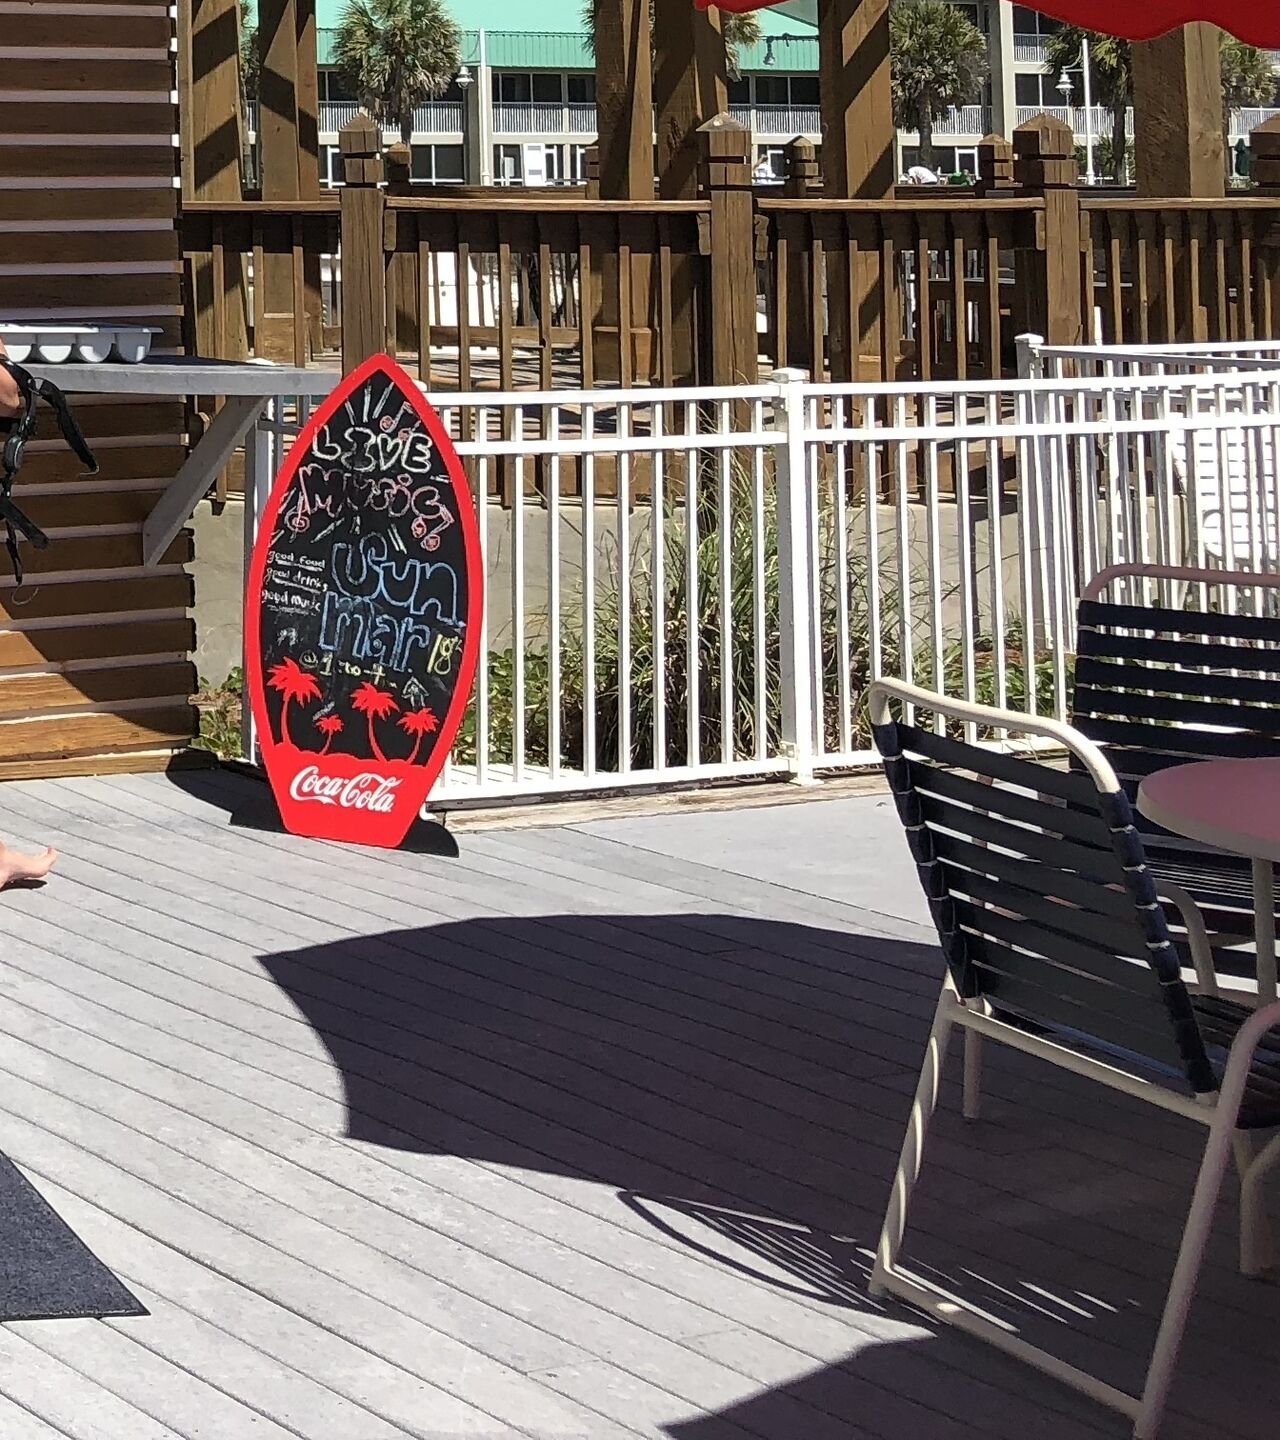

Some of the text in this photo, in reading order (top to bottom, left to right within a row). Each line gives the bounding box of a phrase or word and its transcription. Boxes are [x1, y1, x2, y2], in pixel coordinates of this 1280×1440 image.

[312, 425, 433, 474] LIVE
[267, 549, 294, 564] good
[261, 589, 289, 605] good
[264, 566, 328, 592] good drinks
[331, 532, 457, 625] Sun
[289, 765, 404, 813] Coca-Cola
